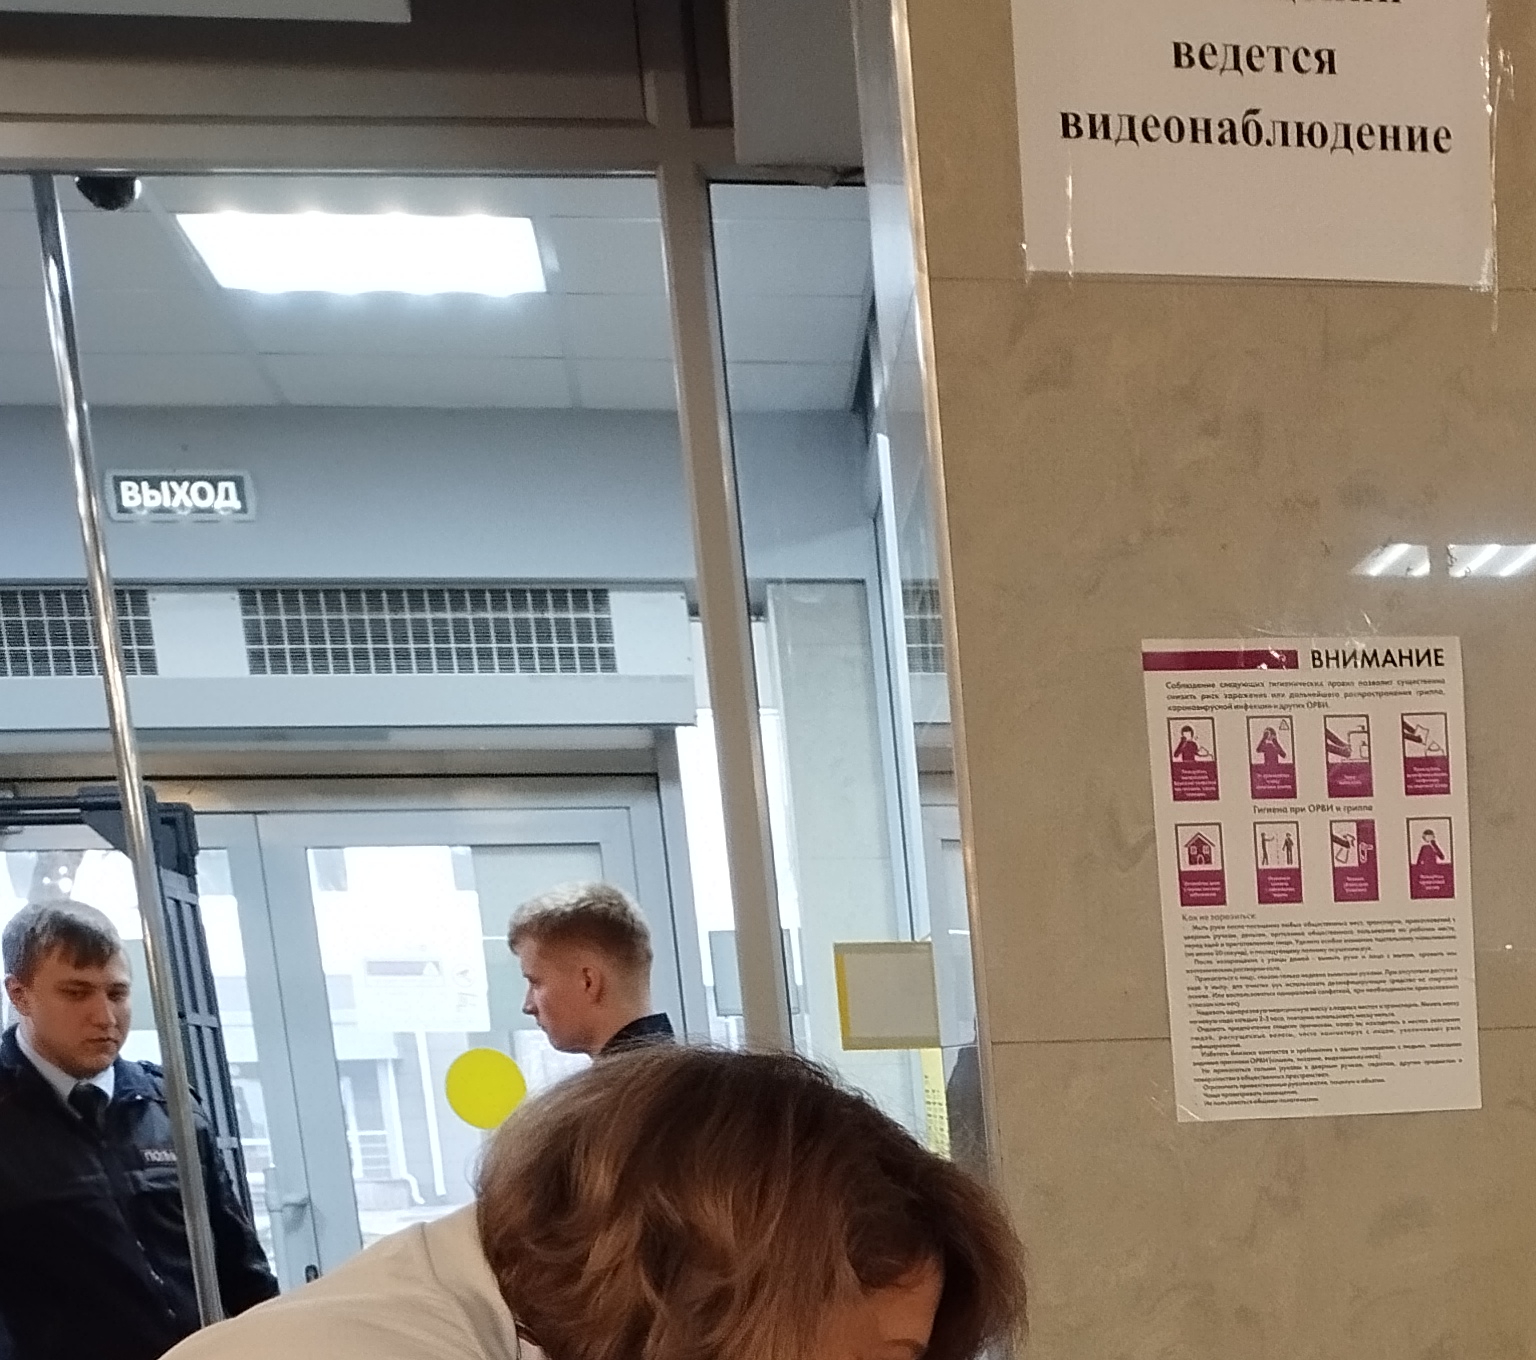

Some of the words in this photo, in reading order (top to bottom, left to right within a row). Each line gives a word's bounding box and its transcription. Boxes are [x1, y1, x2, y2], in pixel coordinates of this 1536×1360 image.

[1172, 40, 1338, 76] ведется
[1060, 108, 1453, 154] видеонаблюдение
[120, 480, 242, 510] ВЫХОД
[1311, 648, 1445, 669] ВНИМАНИЕ
[1252, 804, 1288, 814] Гигиена
[1289, 805, 1306, 815] при
[1307, 803, 1335, 812] ОРВИ
